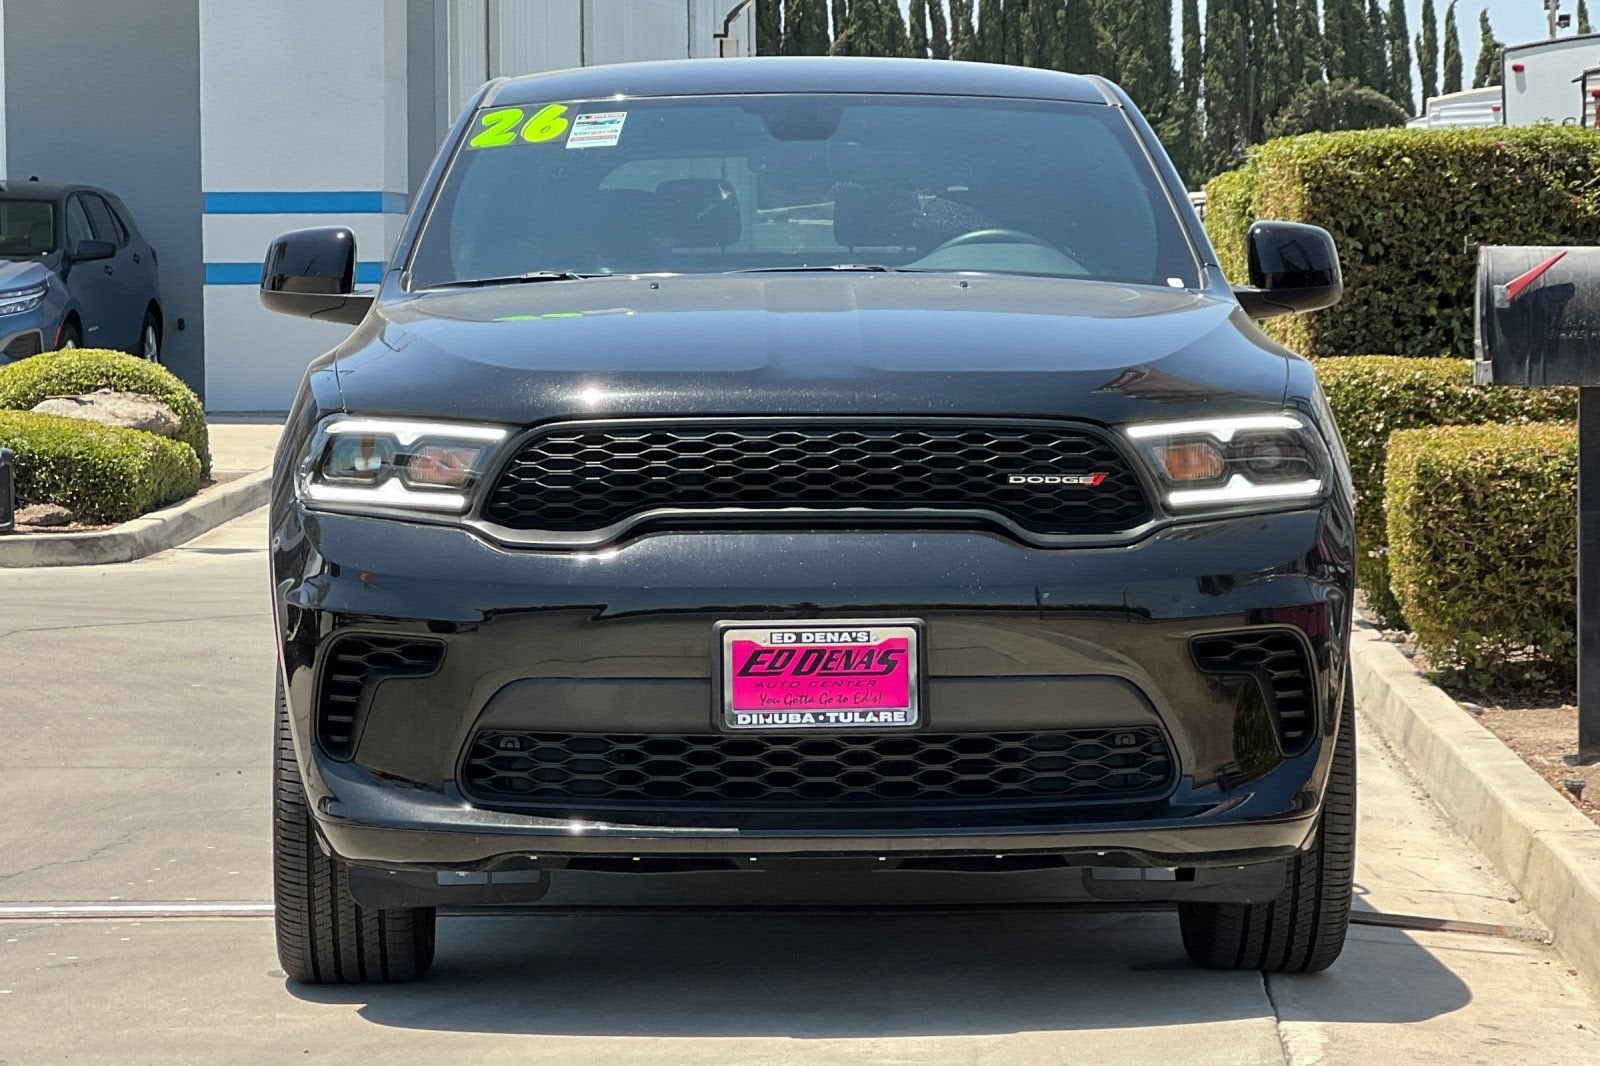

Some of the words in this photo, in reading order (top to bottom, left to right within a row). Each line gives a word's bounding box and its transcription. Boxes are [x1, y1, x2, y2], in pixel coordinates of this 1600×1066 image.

[470, 103, 569, 148] 26
[1009, 476, 1094, 484] DODGE
[771, 632, 797, 644] ED
[801, 631, 869, 643] DENA'S
[736, 649, 797, 677] ED
[791, 649, 906, 677] DENA'S
[754, 680, 801, 689] AUTO
[808, 680, 878, 688] CENTER
[759, 693, 780, 706] You
[783, 693, 814, 706] Gotta
[819, 692, 833, 707] Go
[835, 694, 849, 704] to
[853, 690, 883, 705] Ed's!
[737, 711, 816, 725] DINUBA
[825, 711, 906, 723] TULARE
